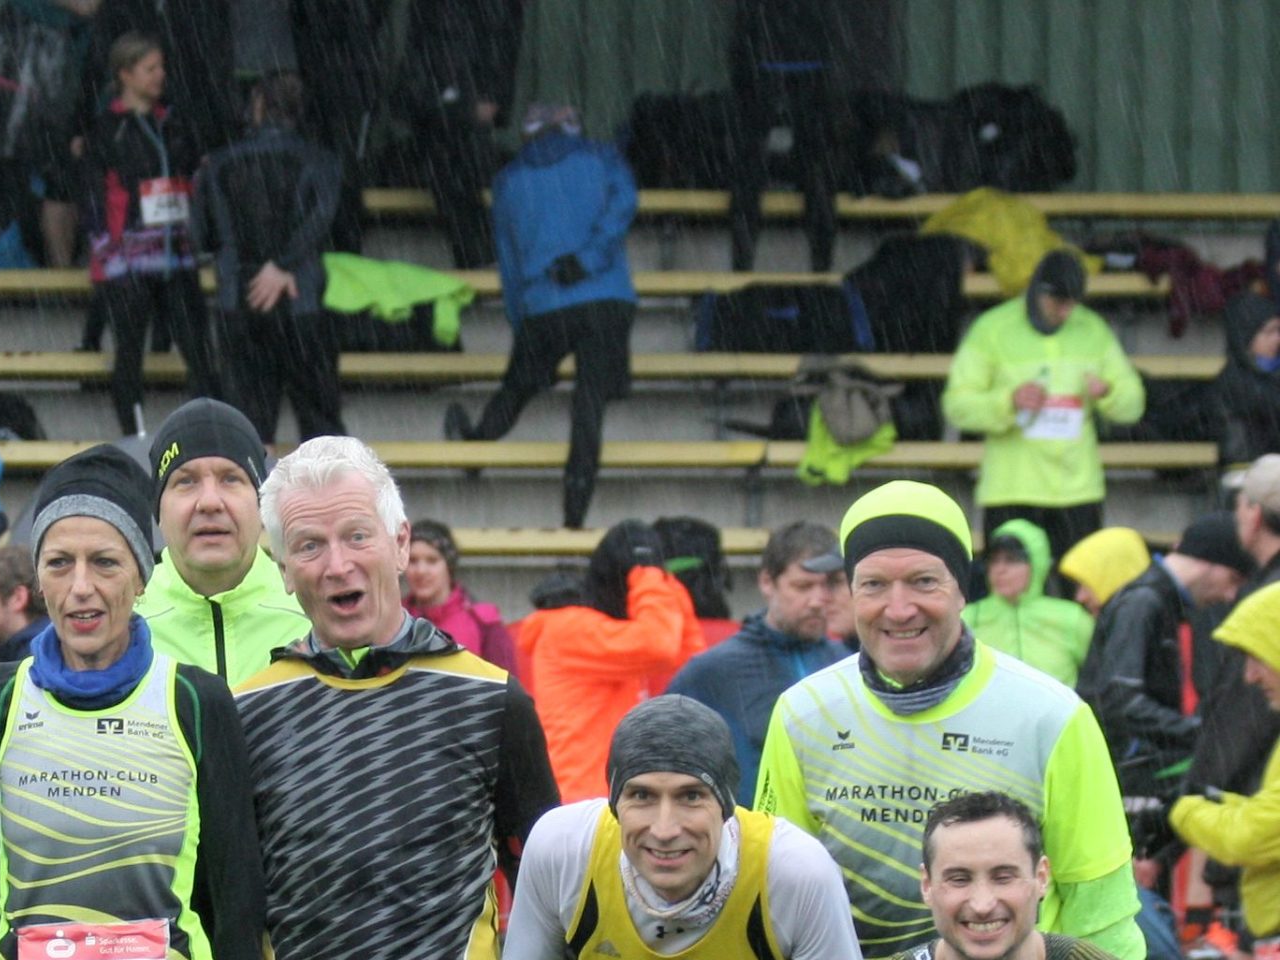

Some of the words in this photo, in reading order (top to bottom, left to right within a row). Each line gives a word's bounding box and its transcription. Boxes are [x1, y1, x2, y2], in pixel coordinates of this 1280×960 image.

[127, 720, 168, 730] Mendener
[127, 728, 149, 737] Bank
[152, 731, 164, 739] eG
[972, 736, 1014, 747] Mendener
[971, 746, 993, 755] Bank
[996, 748, 1009, 757] eG
[19, 770, 159, 786] MARATHON-CLUB
[47, 786, 122, 798] MENDEN
[825, 785, 970, 801] MARATHON-C
[861, 808, 933, 823] MEND
